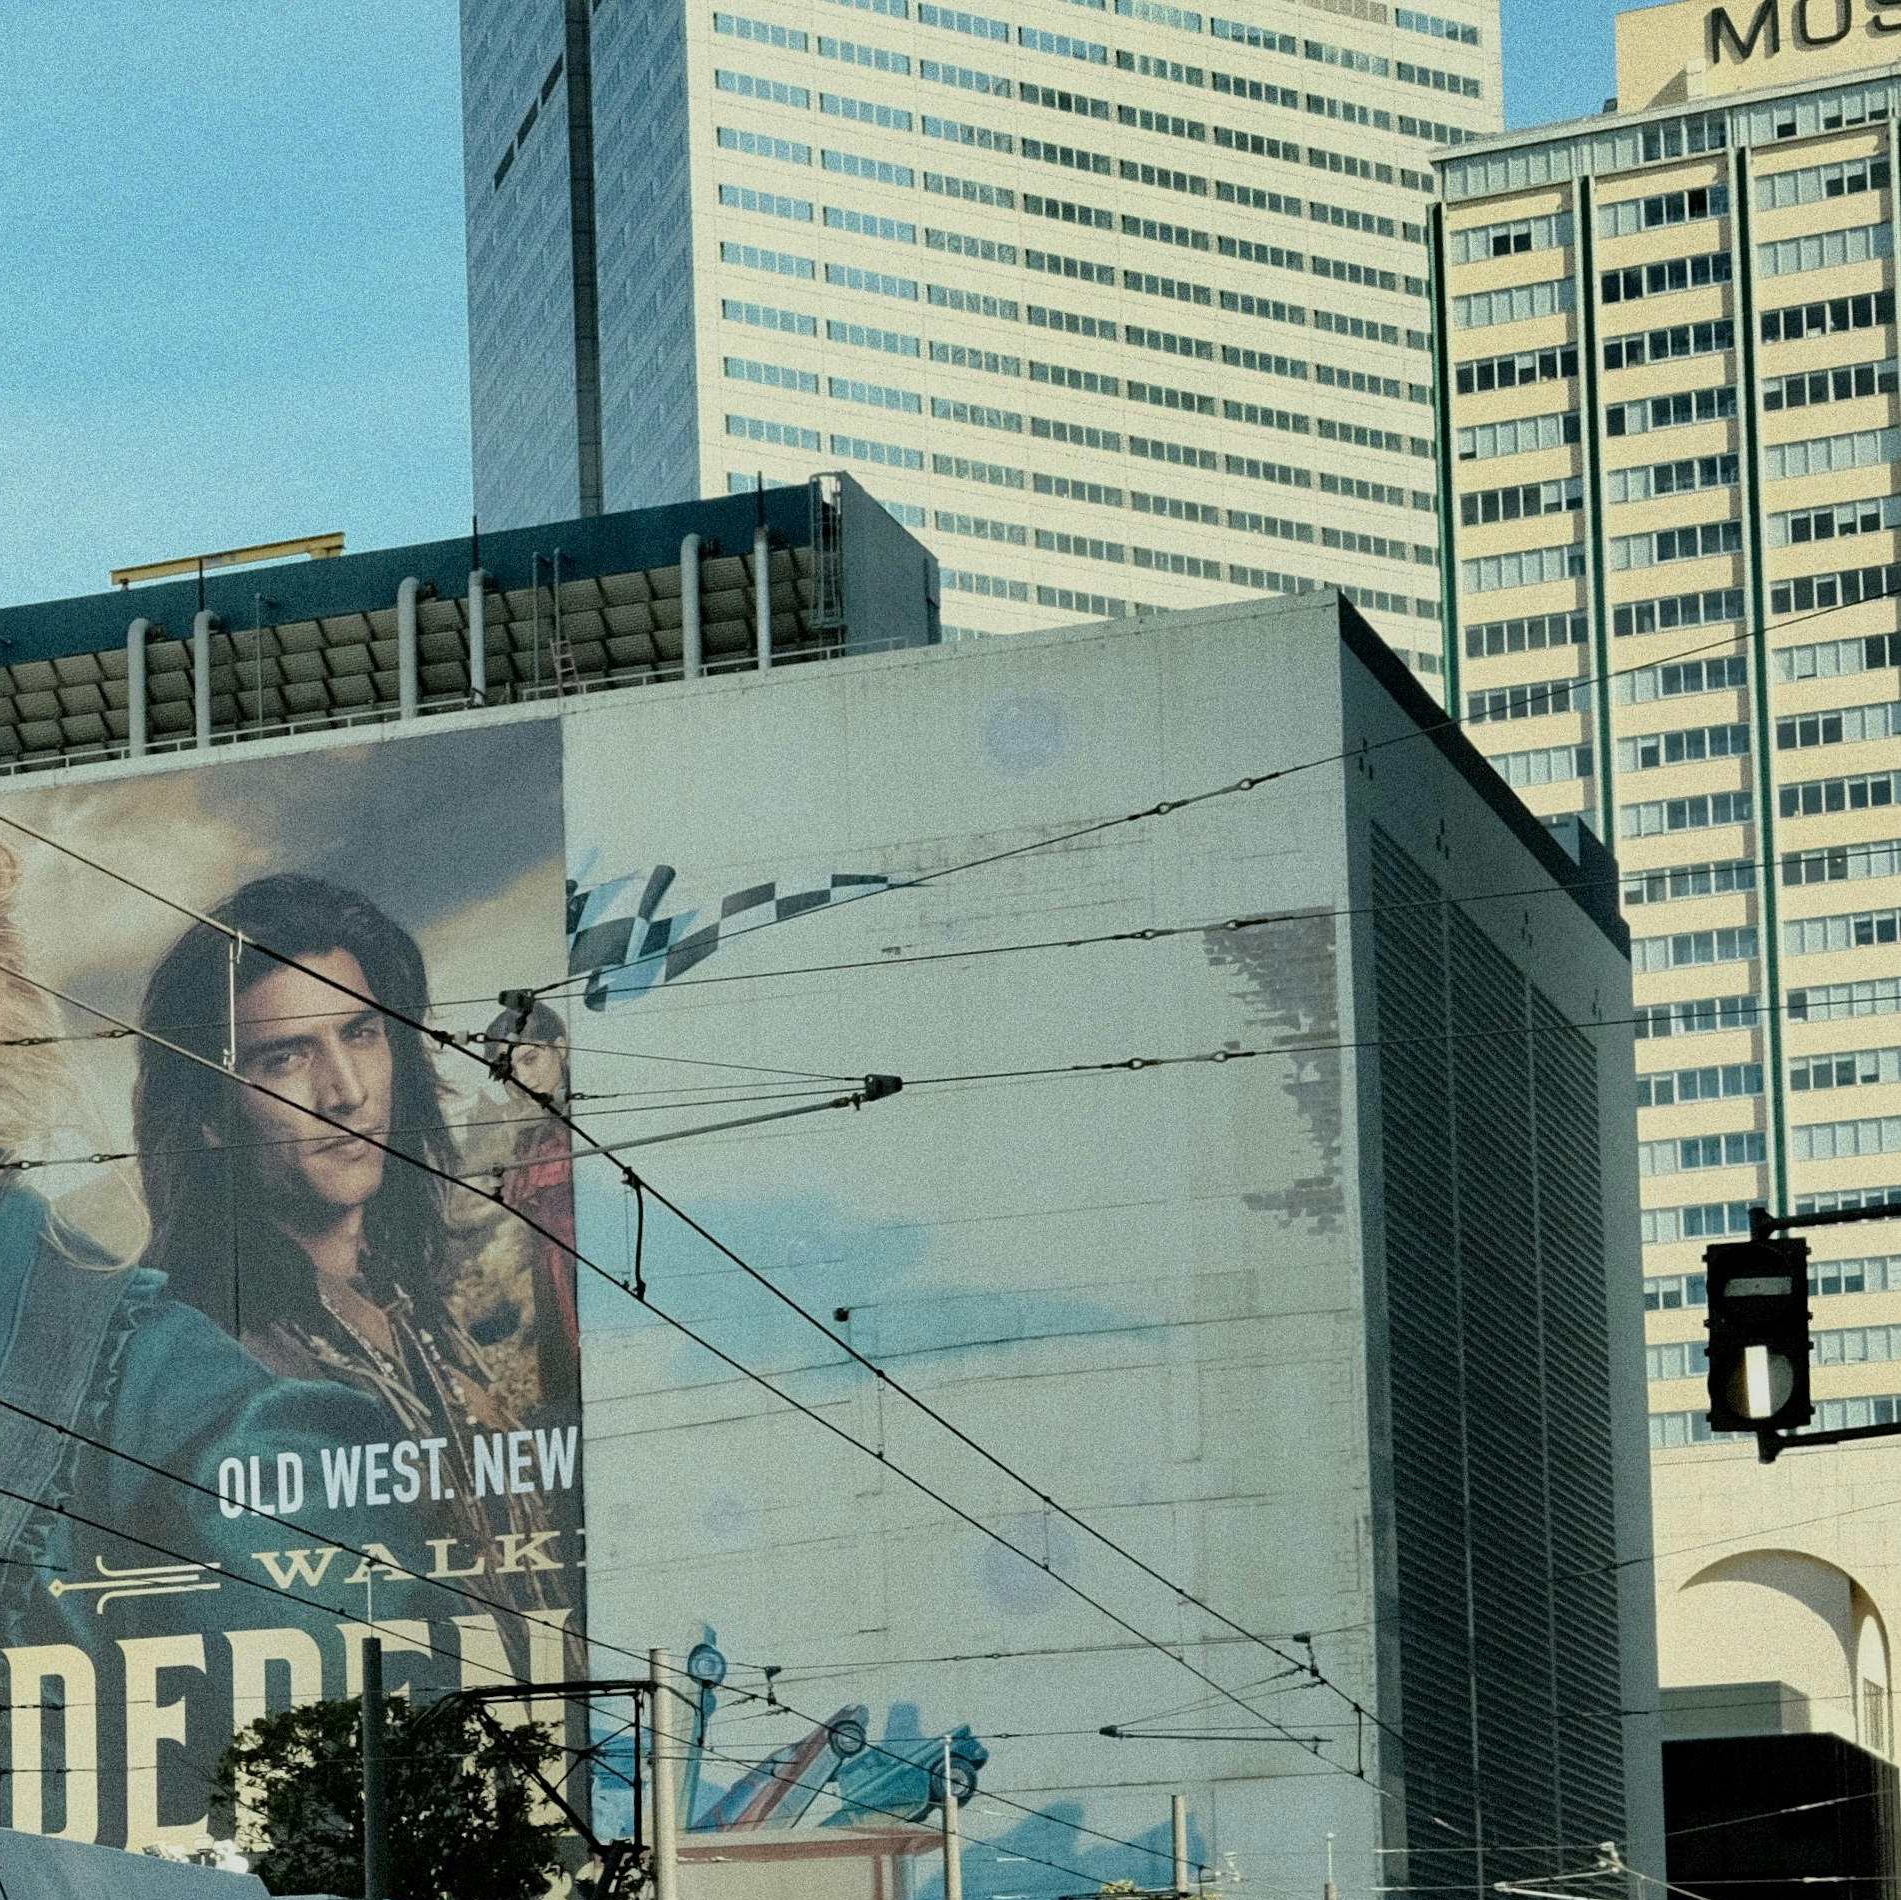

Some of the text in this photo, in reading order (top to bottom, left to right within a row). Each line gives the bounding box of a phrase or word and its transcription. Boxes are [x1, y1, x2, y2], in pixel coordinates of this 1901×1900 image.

[218, 1426, 578, 1519] OLD WEST. NEW
[252, 1528, 586, 1590] WALK
